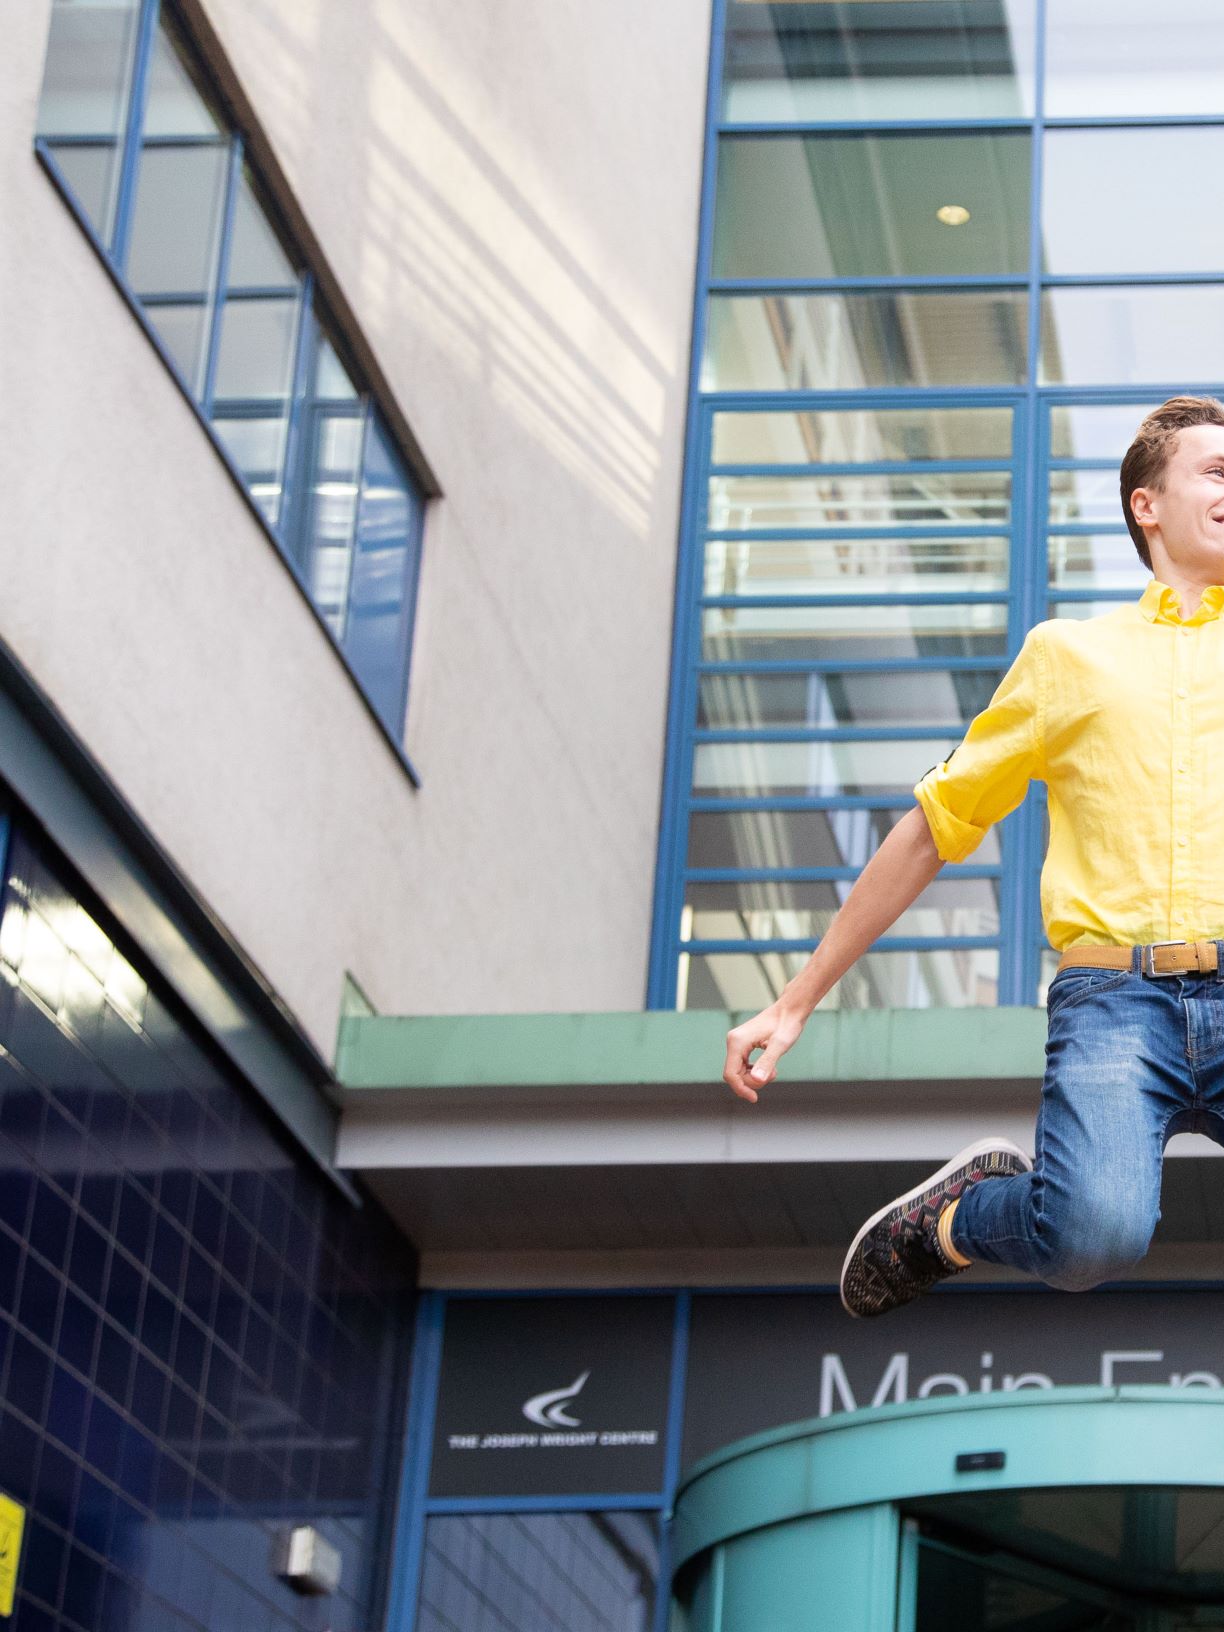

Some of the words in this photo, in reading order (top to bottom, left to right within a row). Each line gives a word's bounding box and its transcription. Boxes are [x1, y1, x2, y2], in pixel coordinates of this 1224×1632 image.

[819, 1352, 1055, 1418] Mi
[448, 1434, 480, 1449] THE
[480, 1433, 538, 1448] JOSEPH
[540, 1431, 598, 1446] WRIGHT
[600, 1430, 659, 1445] CENTRE
